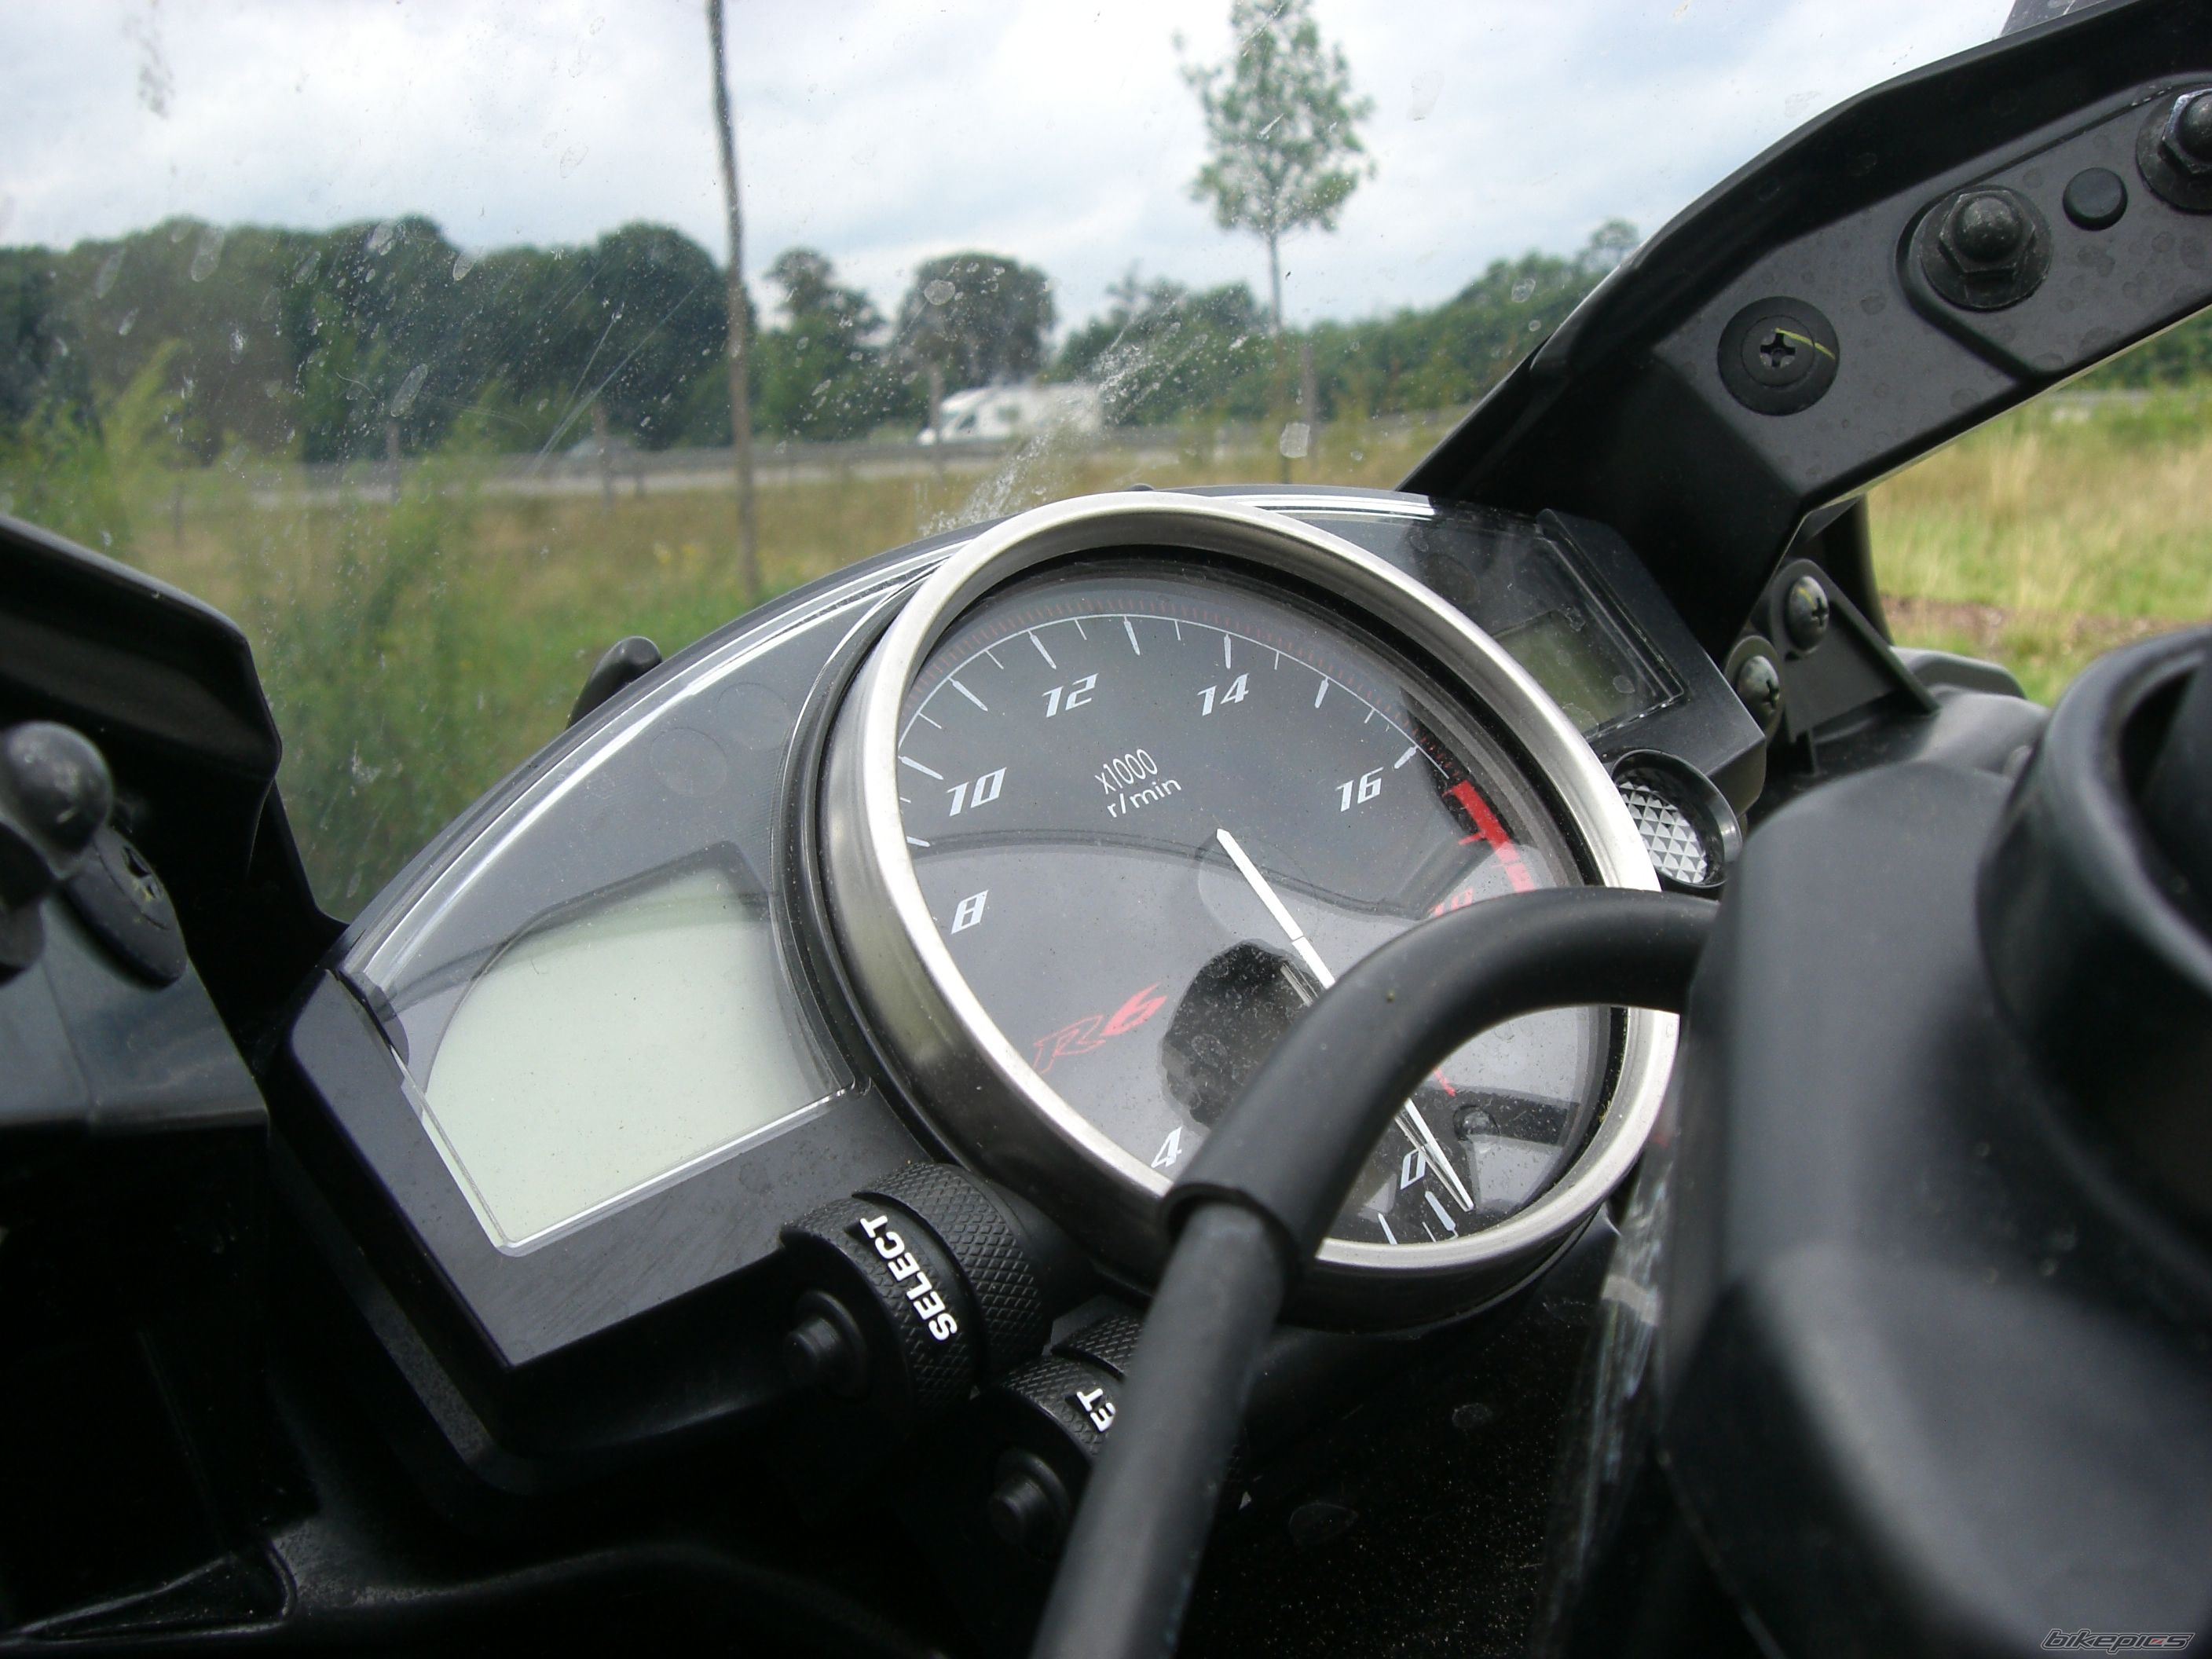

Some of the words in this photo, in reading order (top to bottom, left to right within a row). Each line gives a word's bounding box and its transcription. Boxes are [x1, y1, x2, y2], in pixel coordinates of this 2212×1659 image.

[1042, 673, 1098, 717] 12
[1197, 674, 1249, 716] 14
[947, 767, 1006, 817] 10
[1107, 779, 1181, 818] r/min
[1337, 767, 1382, 811] 16
[951, 890, 989, 934] 8
[1151, 1126, 1182, 1168] 4
[859, 1214, 958, 1340] SELECT
